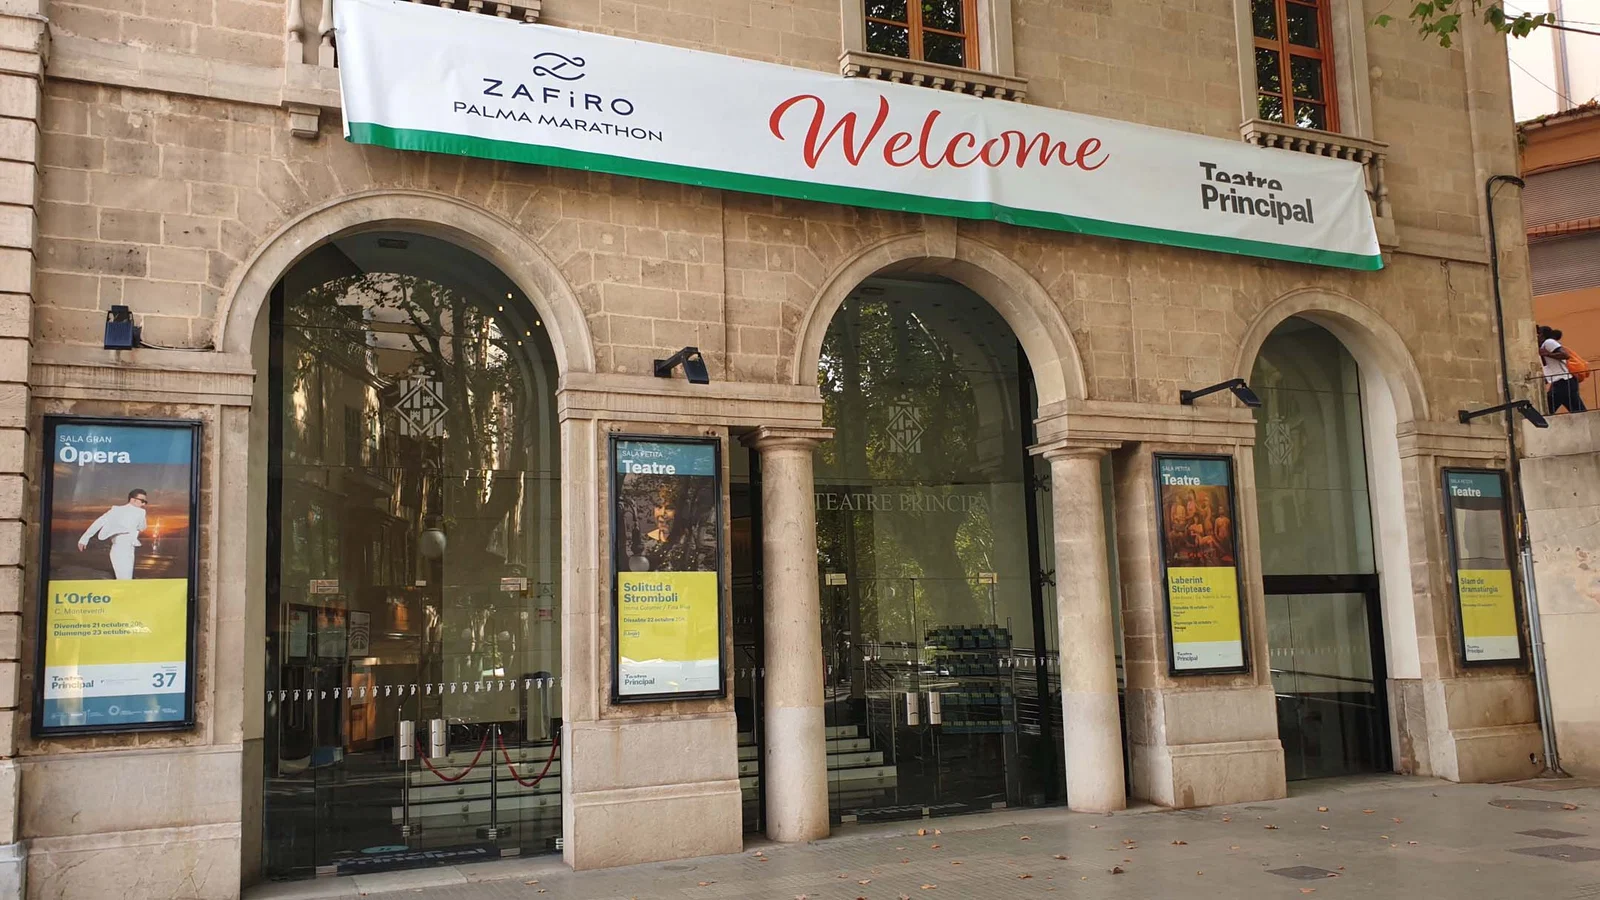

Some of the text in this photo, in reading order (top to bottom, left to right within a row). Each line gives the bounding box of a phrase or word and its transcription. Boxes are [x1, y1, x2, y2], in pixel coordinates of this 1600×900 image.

[454, 101, 663, 142] PALMA MARATHON
[769, 94, 1110, 171] Welcome
[1199, 161, 1283, 191] Teatre
[1201, 183, 1314, 225] Principal
[59, 434, 112, 443] SALA GRAN
[59, 443, 131, 466] Òpera
[622, 460, 676, 475] Teatre
[1162, 473, 1200, 486] Teatre
[1451, 486, 1481, 497] Teatre
[814, 492, 892, 511] TEATRE
[1171, 576, 1203, 584] Laberint
[623, 582, 663, 592] Solitud
[1171, 585, 1211, 594] Striptease
[55, 592, 112, 604] L'Orfeo
[623, 593, 678, 603] Stromboli
[54, 622, 91, 630] Divendres
[92, 621, 101, 629] 21
[101, 621, 129, 629] octubre
[53, 629, 91, 637] Diumenge
[92, 629, 102, 637] 23
[102, 628, 131, 636] octubre
[1176, 654, 1199, 662] Principal
[51, 680, 94, 690] Principal
[152, 672, 177, 688] 37
[624, 677, 655, 687] Principal
